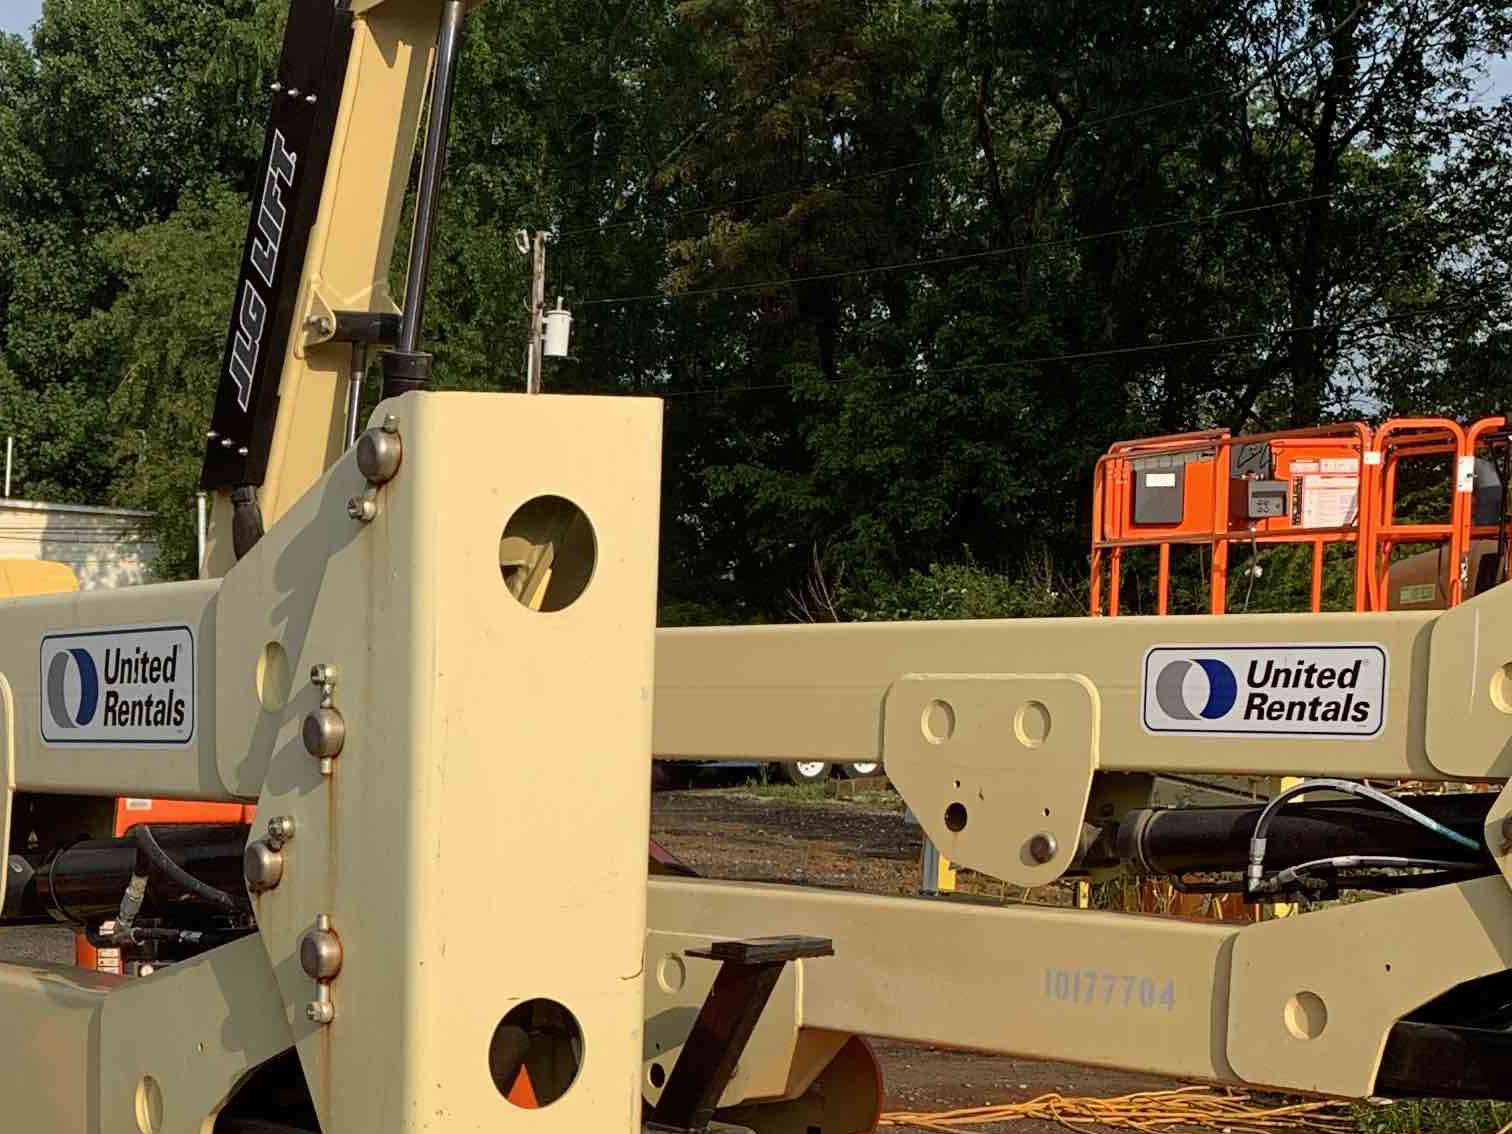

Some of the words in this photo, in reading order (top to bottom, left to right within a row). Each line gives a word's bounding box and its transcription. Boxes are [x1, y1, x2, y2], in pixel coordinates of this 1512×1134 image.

[224, 279, 268, 413] JLG
[250, 128, 297, 287] LIFT
[104, 644, 178, 684] United
[1246, 659, 1362, 689] United
[103, 688, 185, 727] Rentals
[1243, 692, 1370, 722] Rentals
